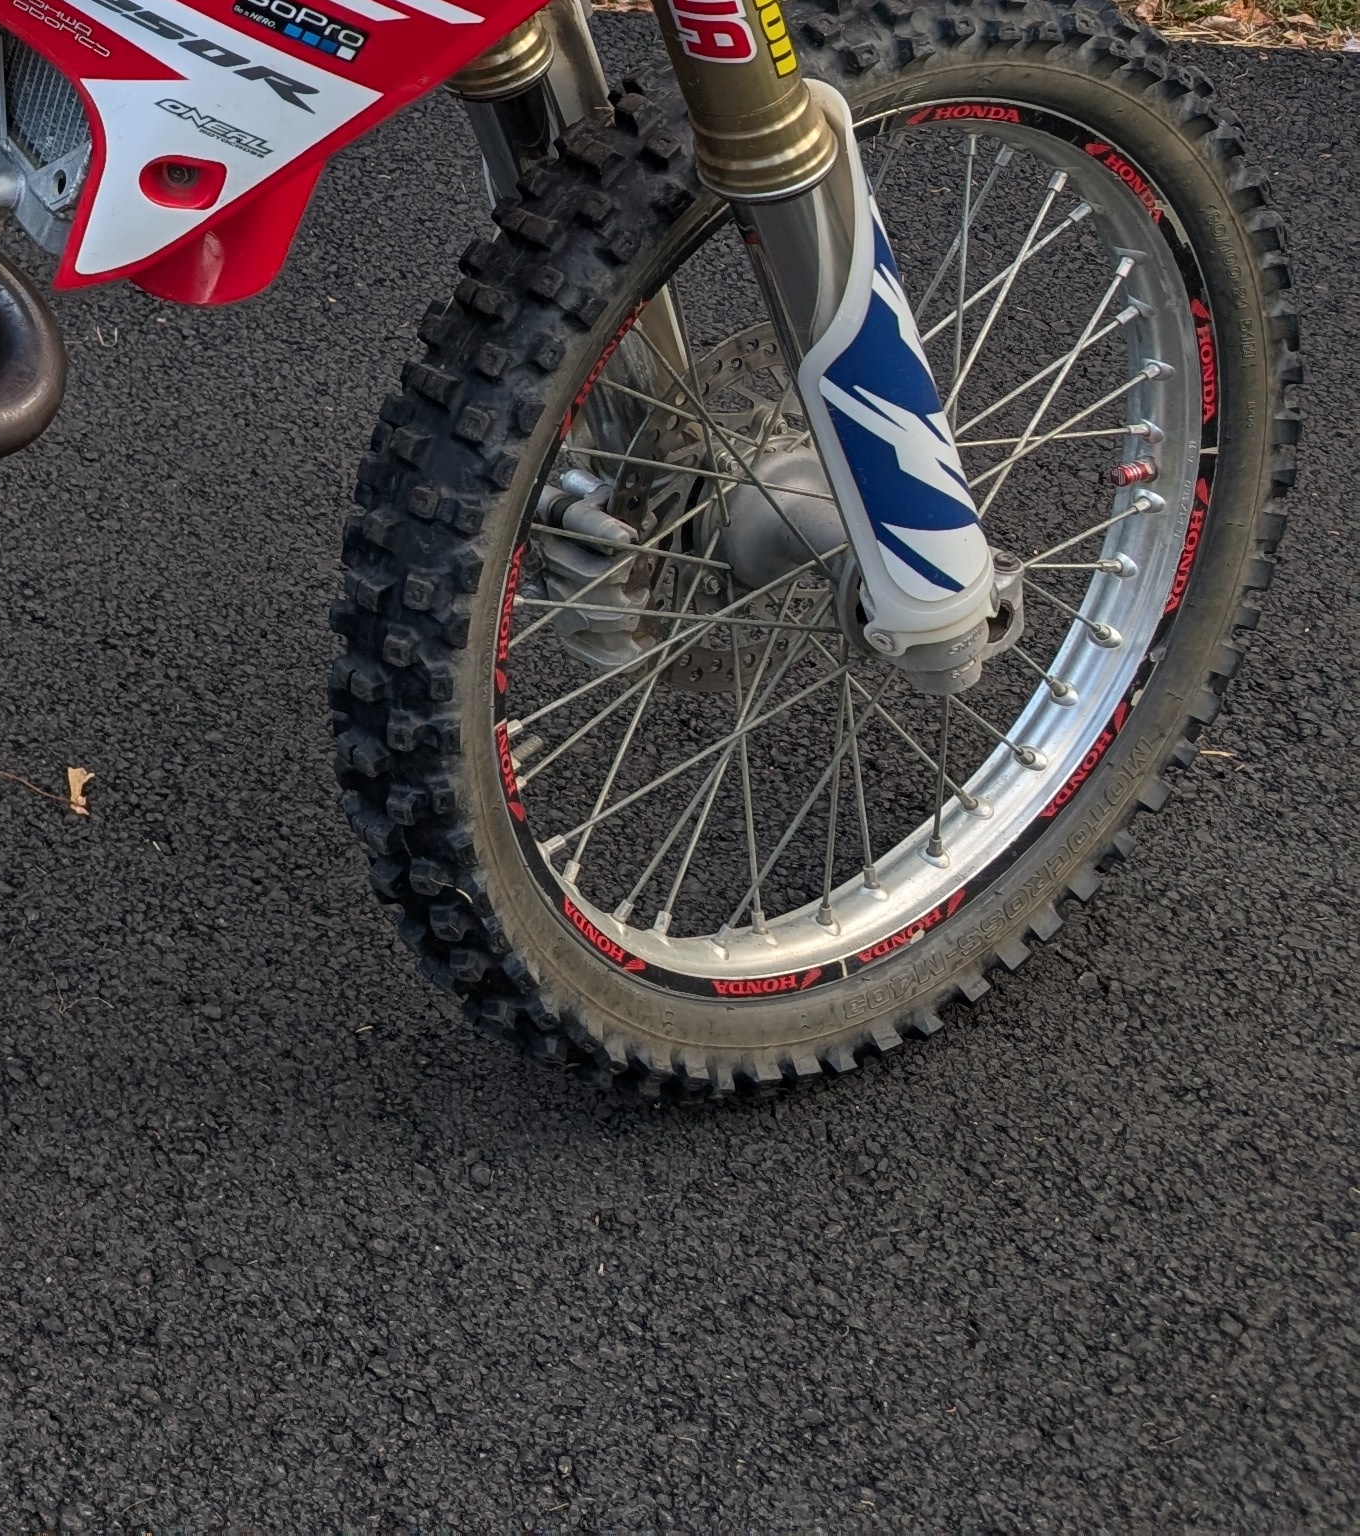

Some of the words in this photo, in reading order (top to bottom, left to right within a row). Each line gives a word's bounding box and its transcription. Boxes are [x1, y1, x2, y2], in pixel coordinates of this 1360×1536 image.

[199, 128, 265, 159] MOTOCROSS
[933, 105, 1023, 125] HONDA
[1102, 150, 1167, 227] HONDA
[1194, 322, 1215, 424] HONDA
[1162, 509, 1204, 617] HONDA
[1038, 727, 1113, 826] HONDA
[558, 892, 627, 962] HONDA
[856, 908, 941, 967] HONDA
[708, 973, 799, 994] HONDA
